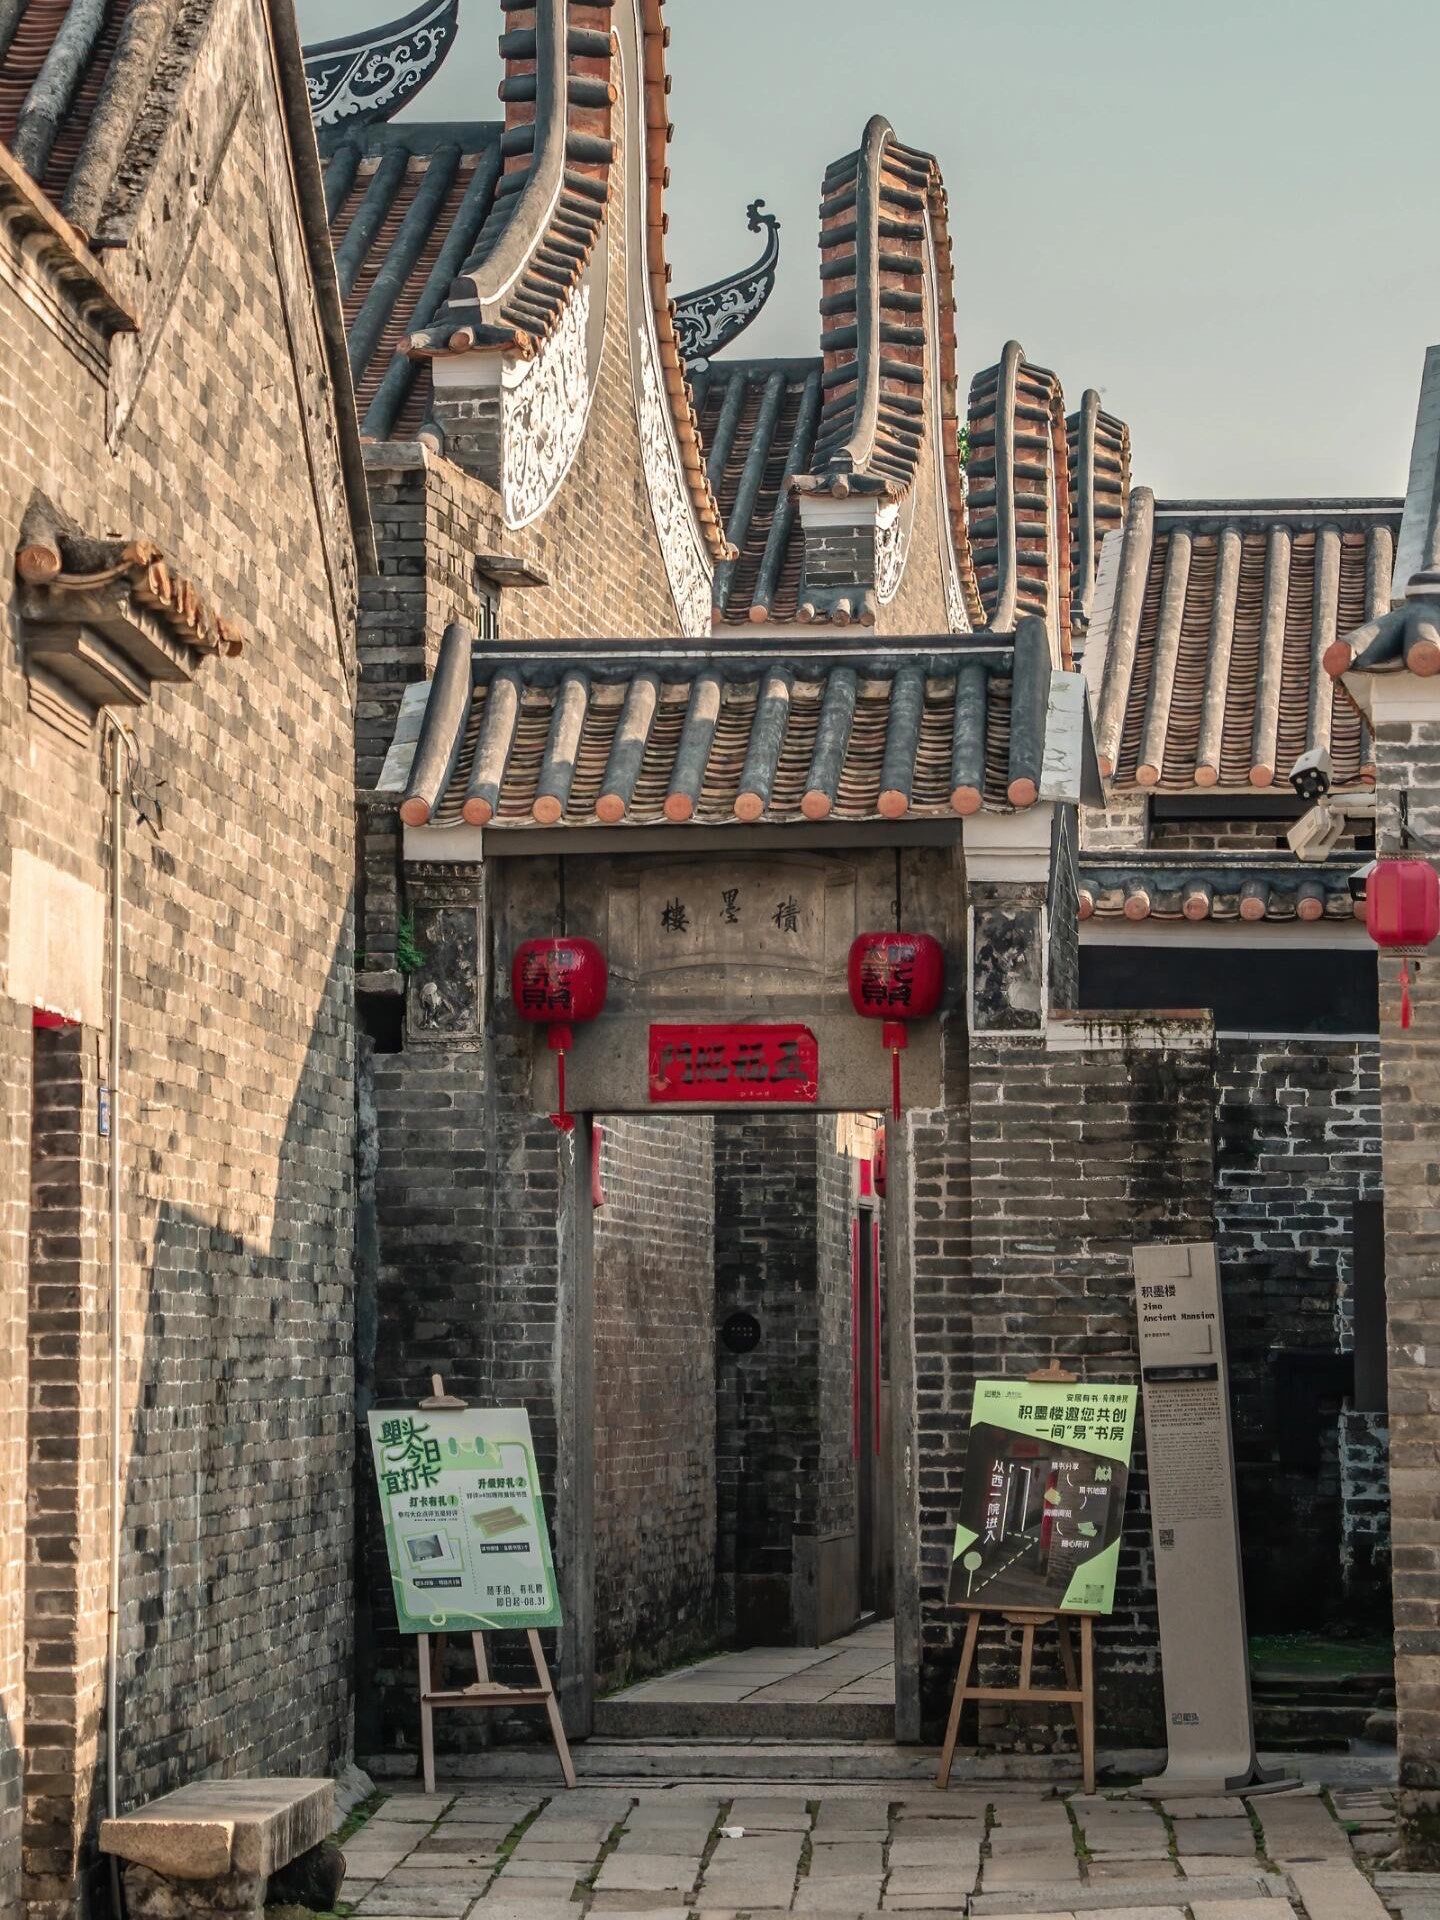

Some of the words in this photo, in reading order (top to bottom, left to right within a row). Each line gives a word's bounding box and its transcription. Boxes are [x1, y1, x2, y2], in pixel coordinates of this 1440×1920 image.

[1141, 1285, 1176, 1298] 积墨楼
[1143, 1303, 1163, 1311] Jimo
[1143, 1313, 1177, 1322] Ancient
[1181, 1311, 1215, 1320] Mansion
[1018, 1405, 1127, 1423] 积墨楼邀您共创
[387, 1439, 441, 1466] 今日
[381, 1464, 441, 1495] 宜打卡
[983, 1460, 1005, 1545] 从西一院进入
